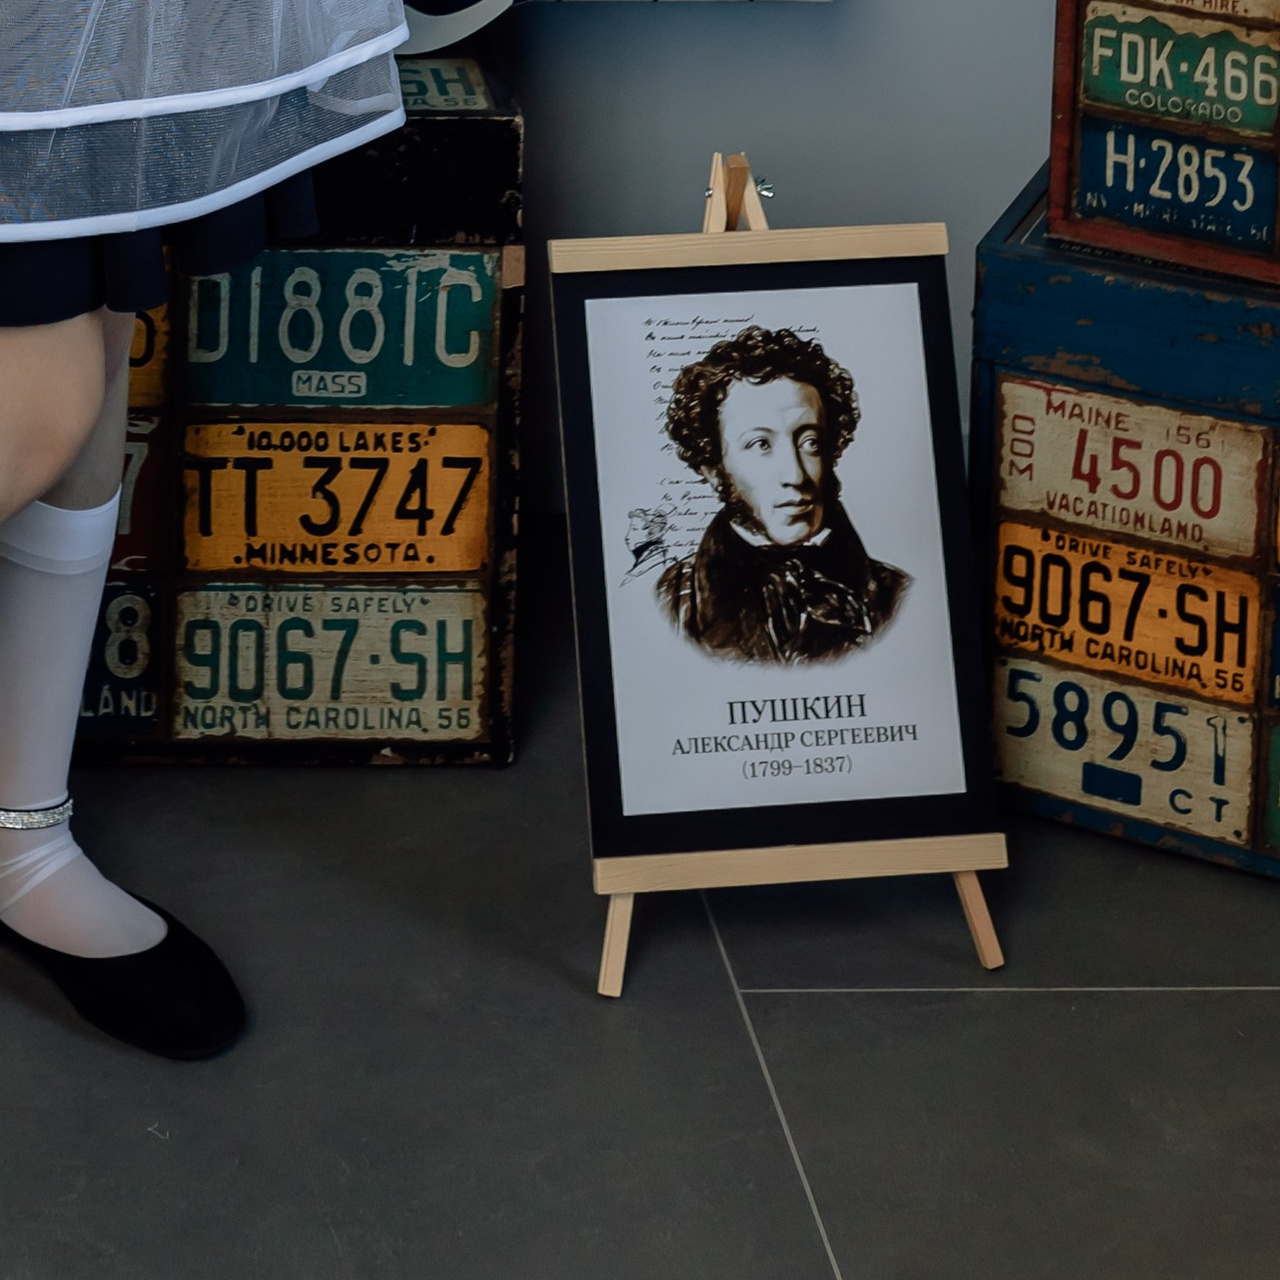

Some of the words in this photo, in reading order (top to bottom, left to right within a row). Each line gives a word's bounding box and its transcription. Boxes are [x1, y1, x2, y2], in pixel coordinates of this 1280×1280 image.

[296, 374, 362, 394] MASS
[1046, 396, 1131, 432] MAINE
[1072, 428, 1222, 519] 4500
[181, 457, 272, 537] TT
[300, 457, 482, 537] 3747
[1055, 534, 1111, 559] DRIVE
[1127, 551, 1199, 579] SAFELY
[246, 595, 313, 613] DRIVE
[331, 595, 416, 613] SAFELY
[1000, 619, 1074, 653] NORTH
[1086, 638, 1202, 681] CAROLINA
[1215, 670, 1244, 692] 56
[183, 705, 269, 730] NORTH
[286, 706, 422, 730] CAROLINA
[438, 706, 471, 729] 56
[728, 694, 868, 725] ПУШКИН
[1006, 669, 1227, 785] 58951
[672, 732, 795, 755] АЛЕКСАНДР
[800, 725, 918, 748] СЕРГЕЕВИЧ
